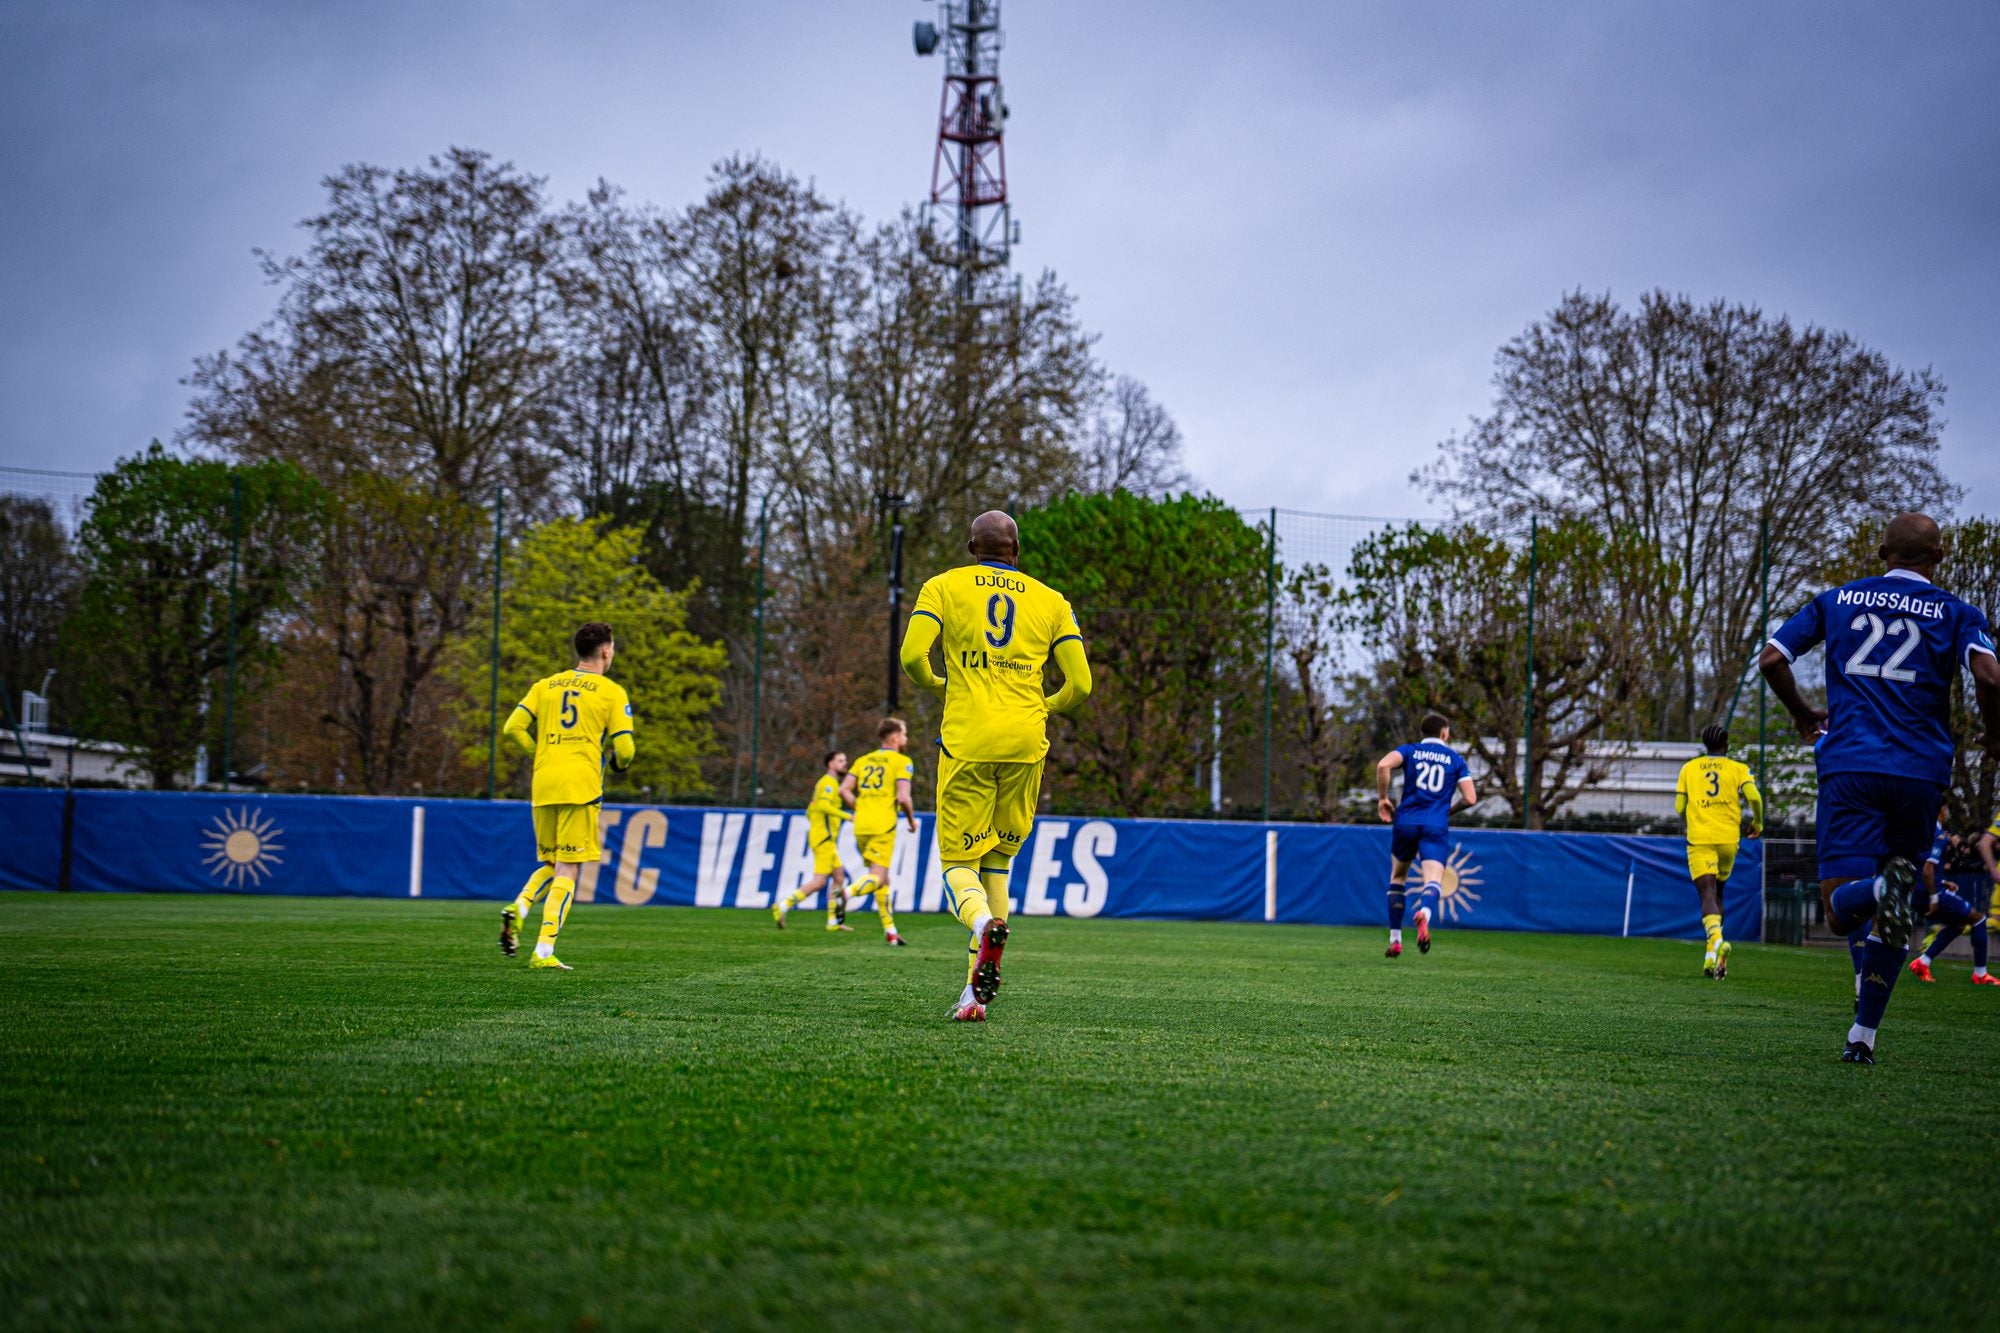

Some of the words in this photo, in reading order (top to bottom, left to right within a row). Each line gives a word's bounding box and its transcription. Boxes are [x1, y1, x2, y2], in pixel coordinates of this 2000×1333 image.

[975, 575, 1026, 593] DJOCO
[1836, 589, 1944, 620] MOUSSADEK
[984, 592, 1017, 649] 9
[1844, 612, 1922, 682] 22
[560, 690, 580, 730] 5
[861, 765, 885, 789] 23
[1415, 761, 1445, 792] 20
[1705, 771, 1720, 797] 3
[575, 809, 668, 905] FC
[694, 812, 1118, 919] VERSAIES
